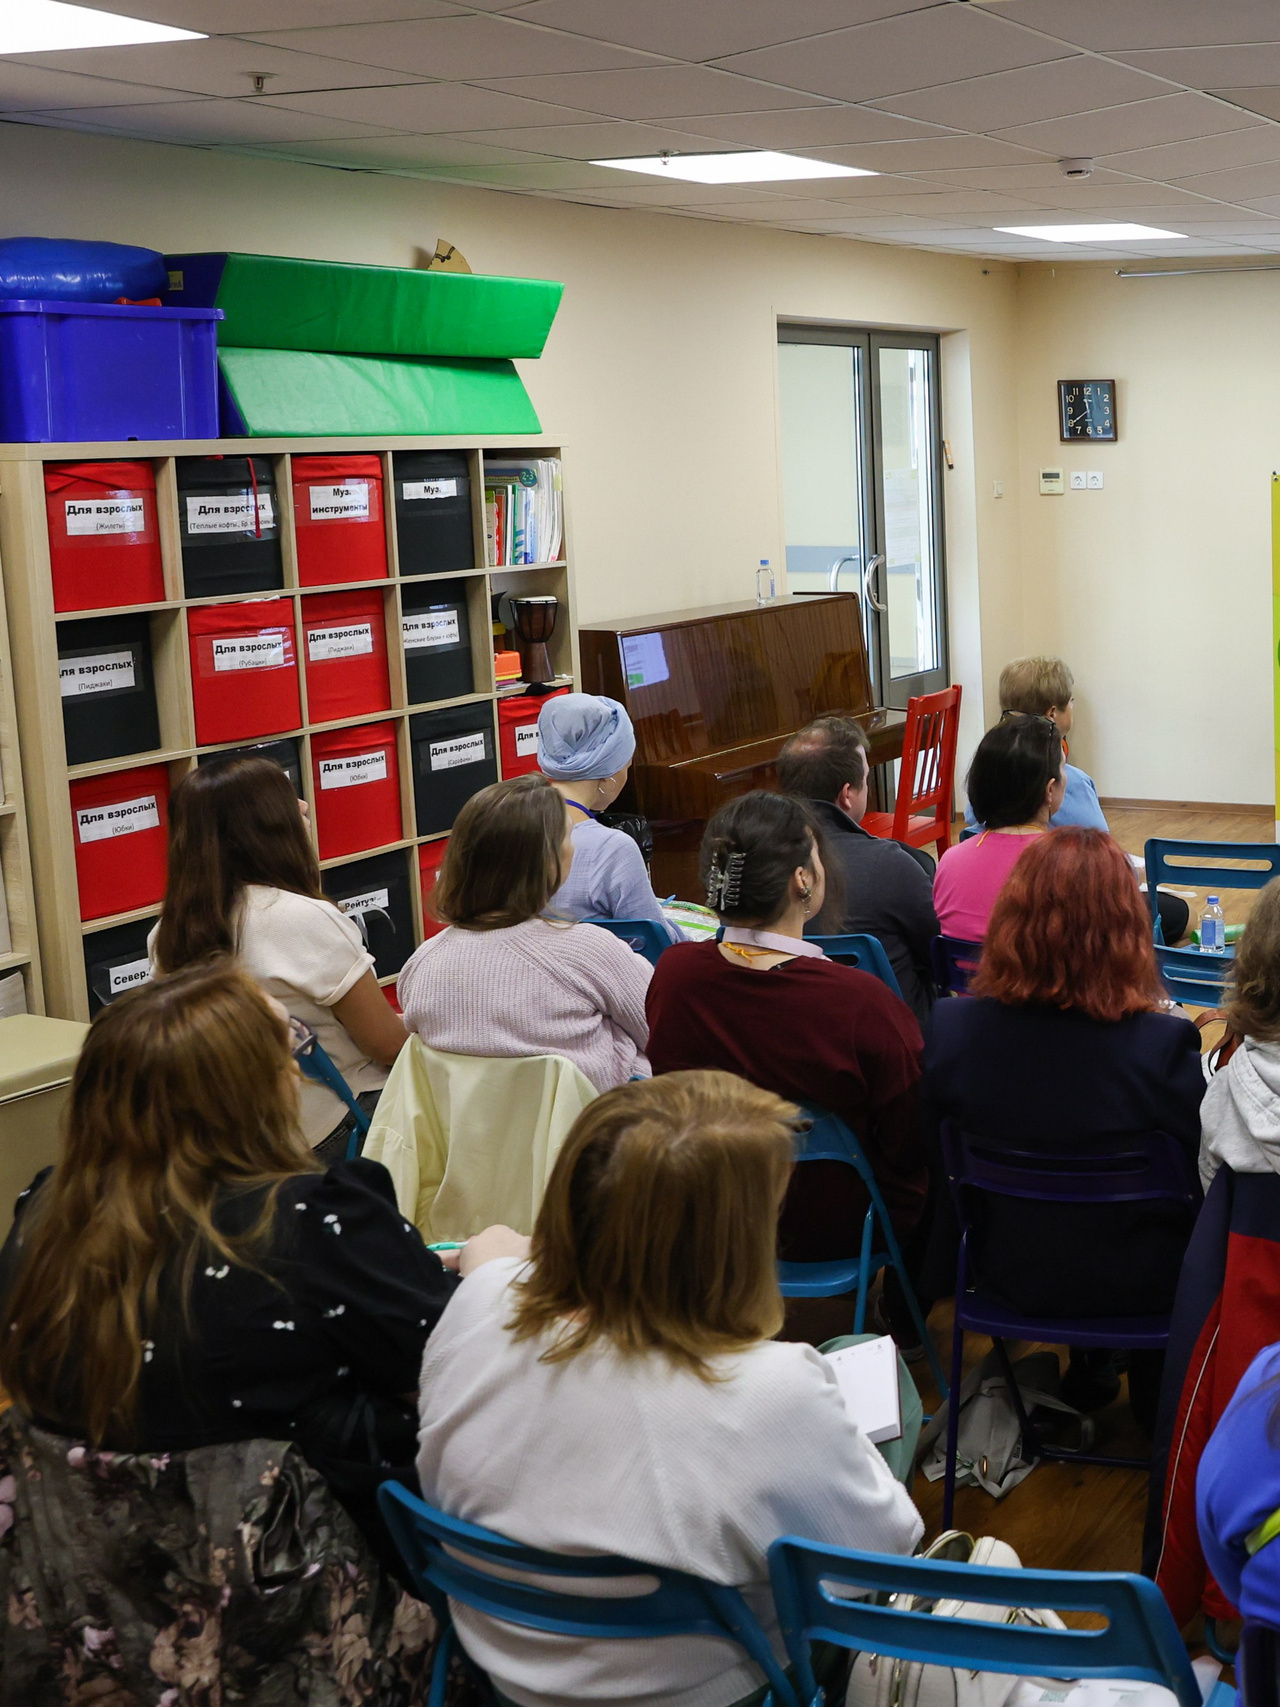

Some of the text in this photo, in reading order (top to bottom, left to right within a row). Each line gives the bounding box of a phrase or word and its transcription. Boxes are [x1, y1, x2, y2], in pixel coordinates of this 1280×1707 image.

[1072, 387, 1079, 396] 11
[1083, 387, 1092, 396] 12
[1097, 387, 1101, 395] 1
[1066, 395, 1074, 403] 10
[1104, 394, 1109, 402] 2
[1076, 426, 1082, 434] 7
[1086, 426, 1092, 434] 6
[1097, 426, 1103, 434] 5
[332, 488, 352, 498] Муз.
[424, 486, 441, 495] Муз.
[67, 505, 142, 516] Для взрослых
[198, 506, 220, 515] Для
[312, 504, 368, 514] инструменты
[96, 522, 125, 531] (Жилеты)
[403, 619, 456, 632] Для взрослых
[309, 628, 369, 643] Для взрослых
[215, 642, 282, 655] Для взрослых
[328, 644, 354, 654] (Пиджаки)
[239, 658, 267, 668] (Рубашки)
[59, 660, 132, 678] ля взрослых
[78, 680, 112, 691] (Пиджаки)
[517, 732, 533, 742] Для
[431, 740, 483, 757] Для взрослых
[323, 755, 384, 773] Для взрослых
[448, 755, 472, 766] (Сарафаны)
[350, 773, 368, 783] (Юбки)
[80, 802, 155, 826] Для взрослых
[112, 823, 134, 835] (Юбки)
[345, 896, 381, 910] Рейтуз
